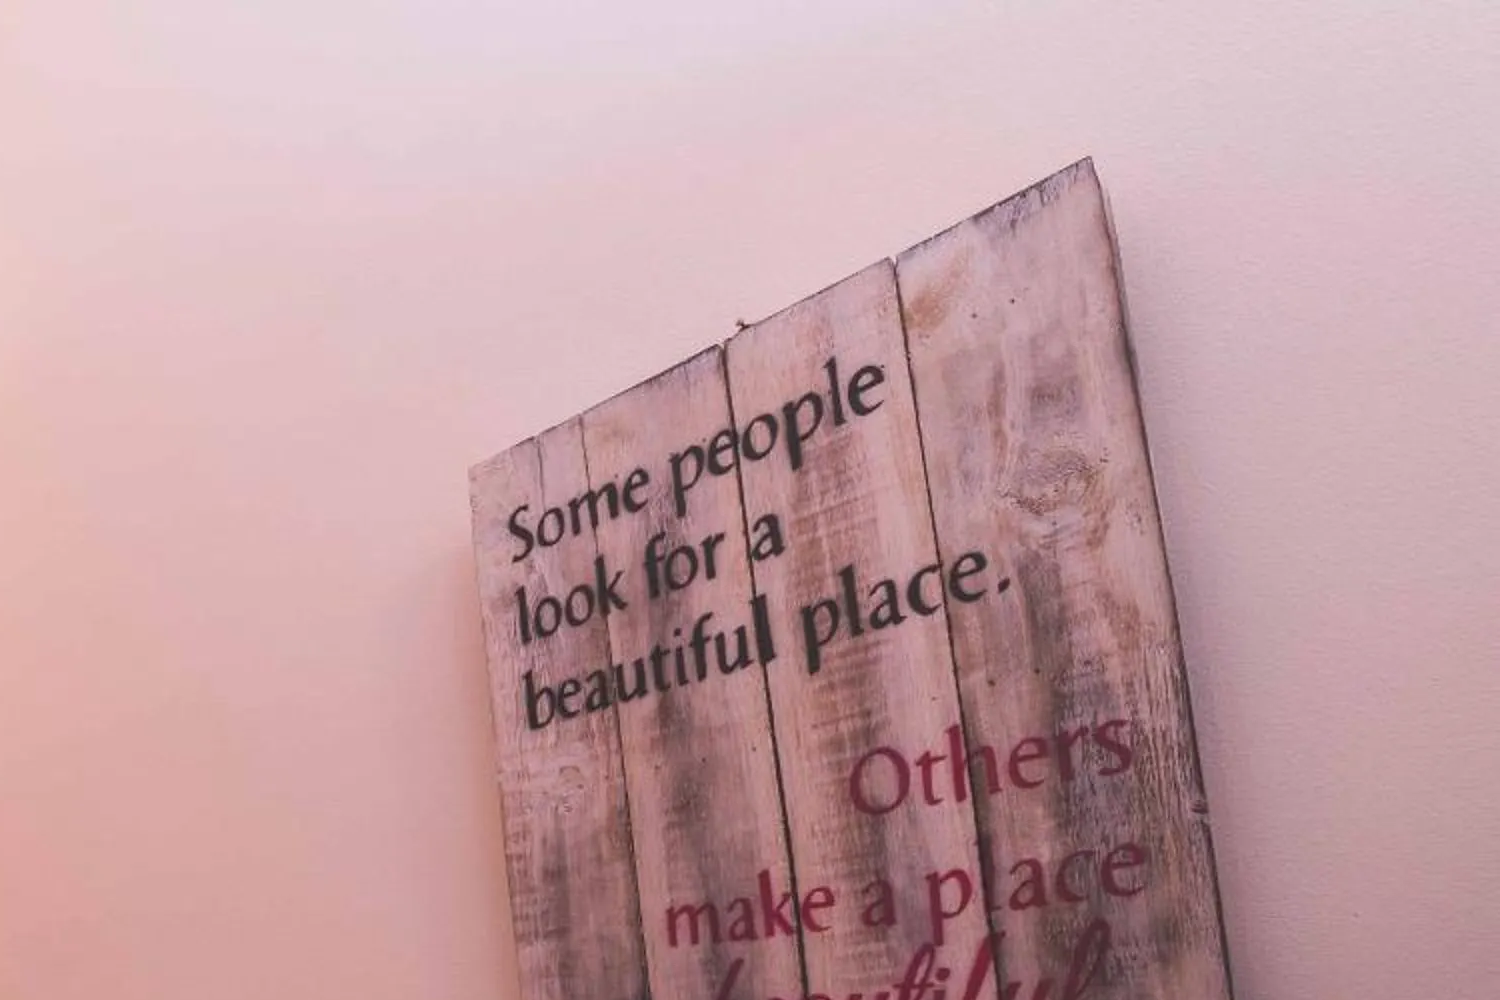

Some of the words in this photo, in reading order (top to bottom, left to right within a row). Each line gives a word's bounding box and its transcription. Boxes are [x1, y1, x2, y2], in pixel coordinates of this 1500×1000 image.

[507, 466, 650, 563] Some
[669, 356, 886, 519] people
[515, 554, 628, 646] look
[643, 529, 725, 599] for
[749, 512, 786, 562] a
[522, 593, 778, 730] beautiful
[800, 549, 1011, 675] place.
[849, 717, 1134, 815] Others
[665, 869, 836, 948] make
[862, 877, 897, 927] a
[925, 840, 1145, 946] place
